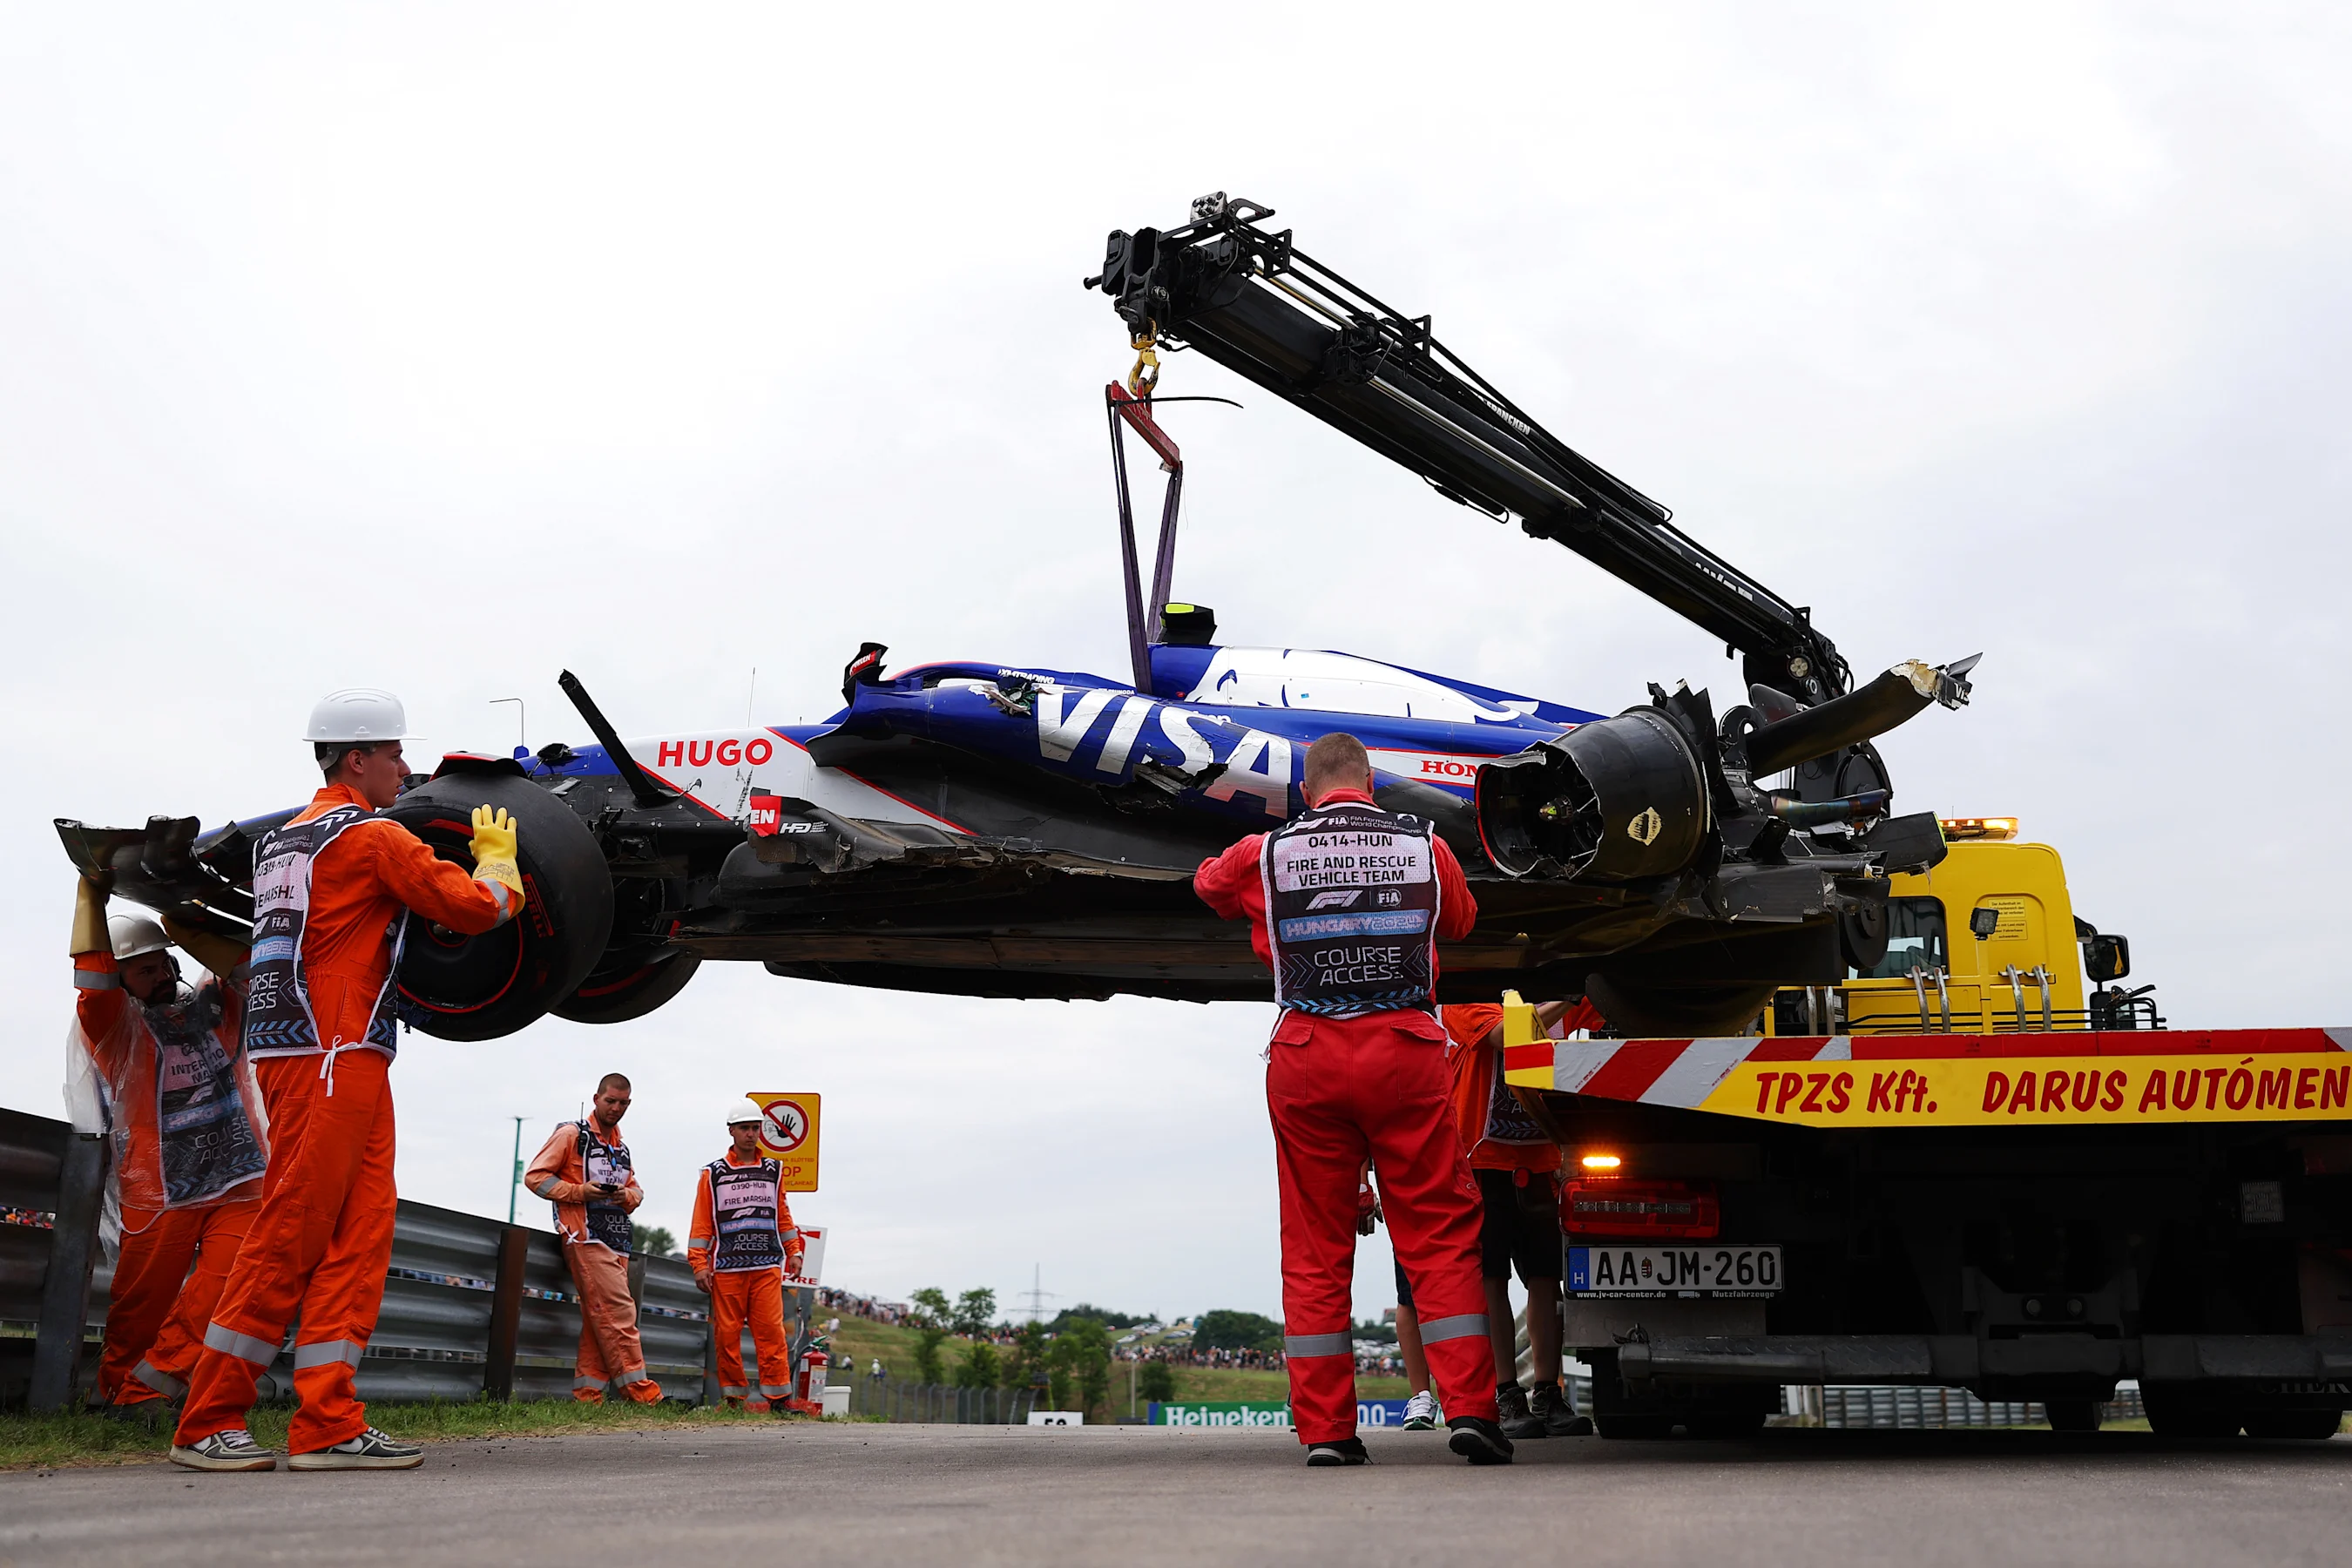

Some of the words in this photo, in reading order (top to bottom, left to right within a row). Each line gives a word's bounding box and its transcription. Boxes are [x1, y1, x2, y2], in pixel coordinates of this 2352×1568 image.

[658, 738, 774, 767] HUGO
[1037, 684, 1292, 820] VISA
[1421, 760, 1478, 778] HON
[1371, 821, 1423, 835] Championship
[1308, 835, 1393, 848] 0414-HUN
[1287, 858, 1319, 873] FIRE
[1323, 857, 1355, 869] AND
[1359, 855, 1416, 868] RESCUE
[1299, 872, 1360, 887] VEHICLE
[1363, 869, 1404, 883] TEAM
[1314, 947, 1402, 968] COURSE
[249, 971, 280, 997] OURSE
[1320, 964, 1404, 987] ACCESS
[248, 991, 277, 1012] CESS
[1756, 1071, 1854, 1114] TPZS
[1867, 1069, 1937, 1113] Kft.
[1982, 1070, 2127, 1115] DARUS
[2139, 1057, 2351, 1114] AUTÓMEN
[781, 1166, 801, 1177] OP
[724, 1197, 741, 1206] FIRE
[733, 1242, 769, 1252] ACCESS
[1596, 1251, 1639, 1286] AA
[1657, 1251, 1775, 1286] JM-260
[782, 1274, 818, 1286] FRE
[1573, 1272, 1585, 1285] H
[1577, 1290, 1666, 1299] www.jv-car-center.de
[1712, 1290, 1775, 1299] Nutzfahrzeuge
[1165, 1405, 1288, 1426] Heineken
